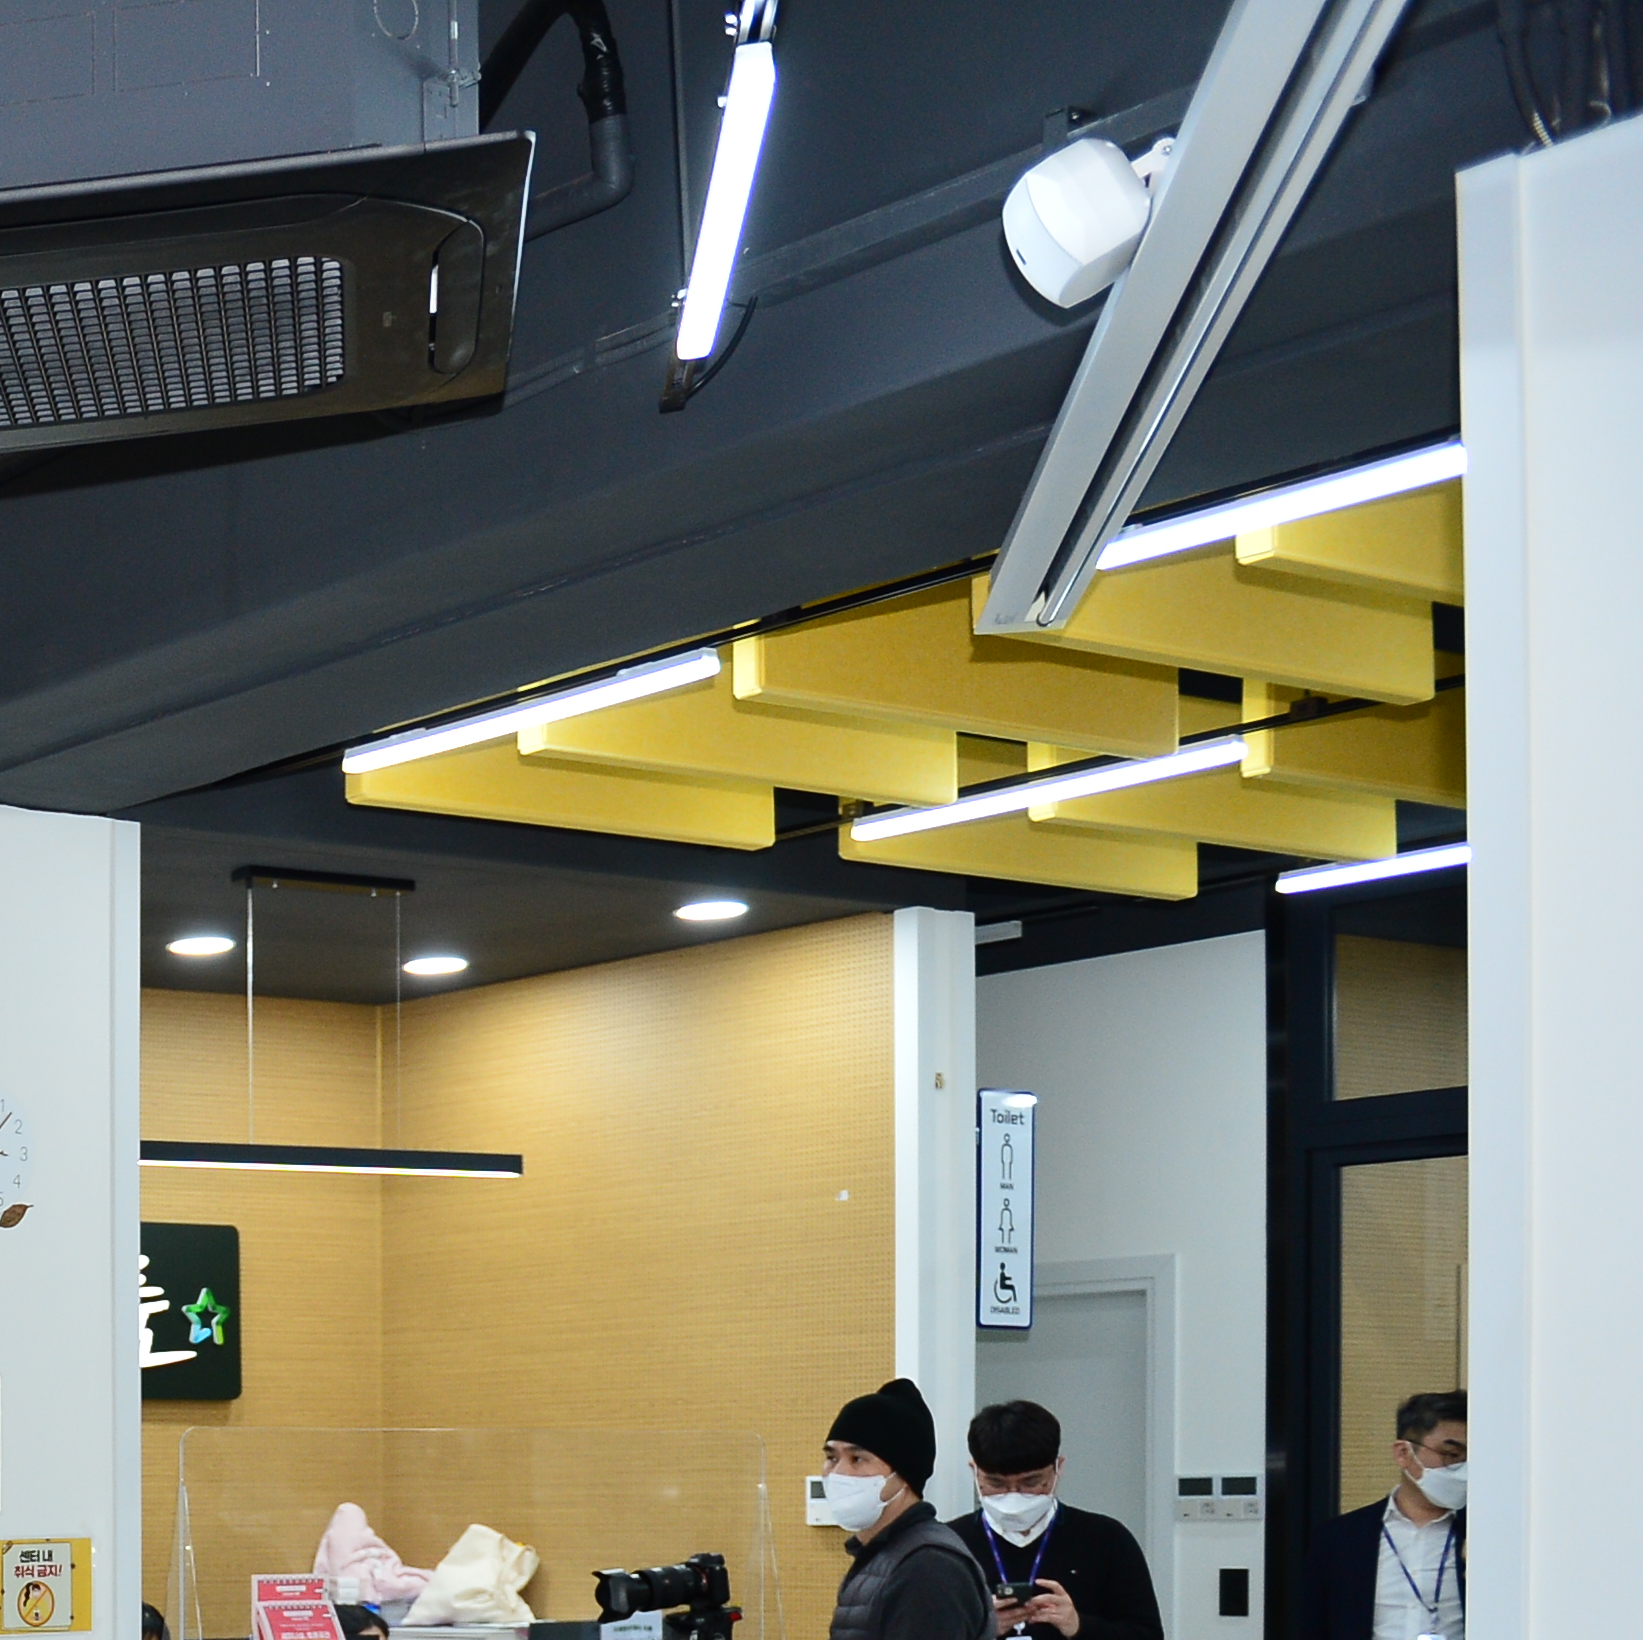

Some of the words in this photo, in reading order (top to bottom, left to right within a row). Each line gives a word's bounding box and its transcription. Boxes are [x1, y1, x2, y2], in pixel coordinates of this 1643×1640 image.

[989, 1108, 1025, 1126] Toilet
[14, 1118, 23, 1135] 2
[19, 1146, 28, 1162] 3
[12, 1174, 21, 1189] 4
[999, 1182, 1015, 1191] MAN
[989, 1305, 1021, 1316] DISABLED
[19, 1549, 40, 1563] 센터
[42, 1549, 53, 1562] 내
[14, 1564, 35, 1578] 취식
[37, 1564, 63, 1578] 금지!
